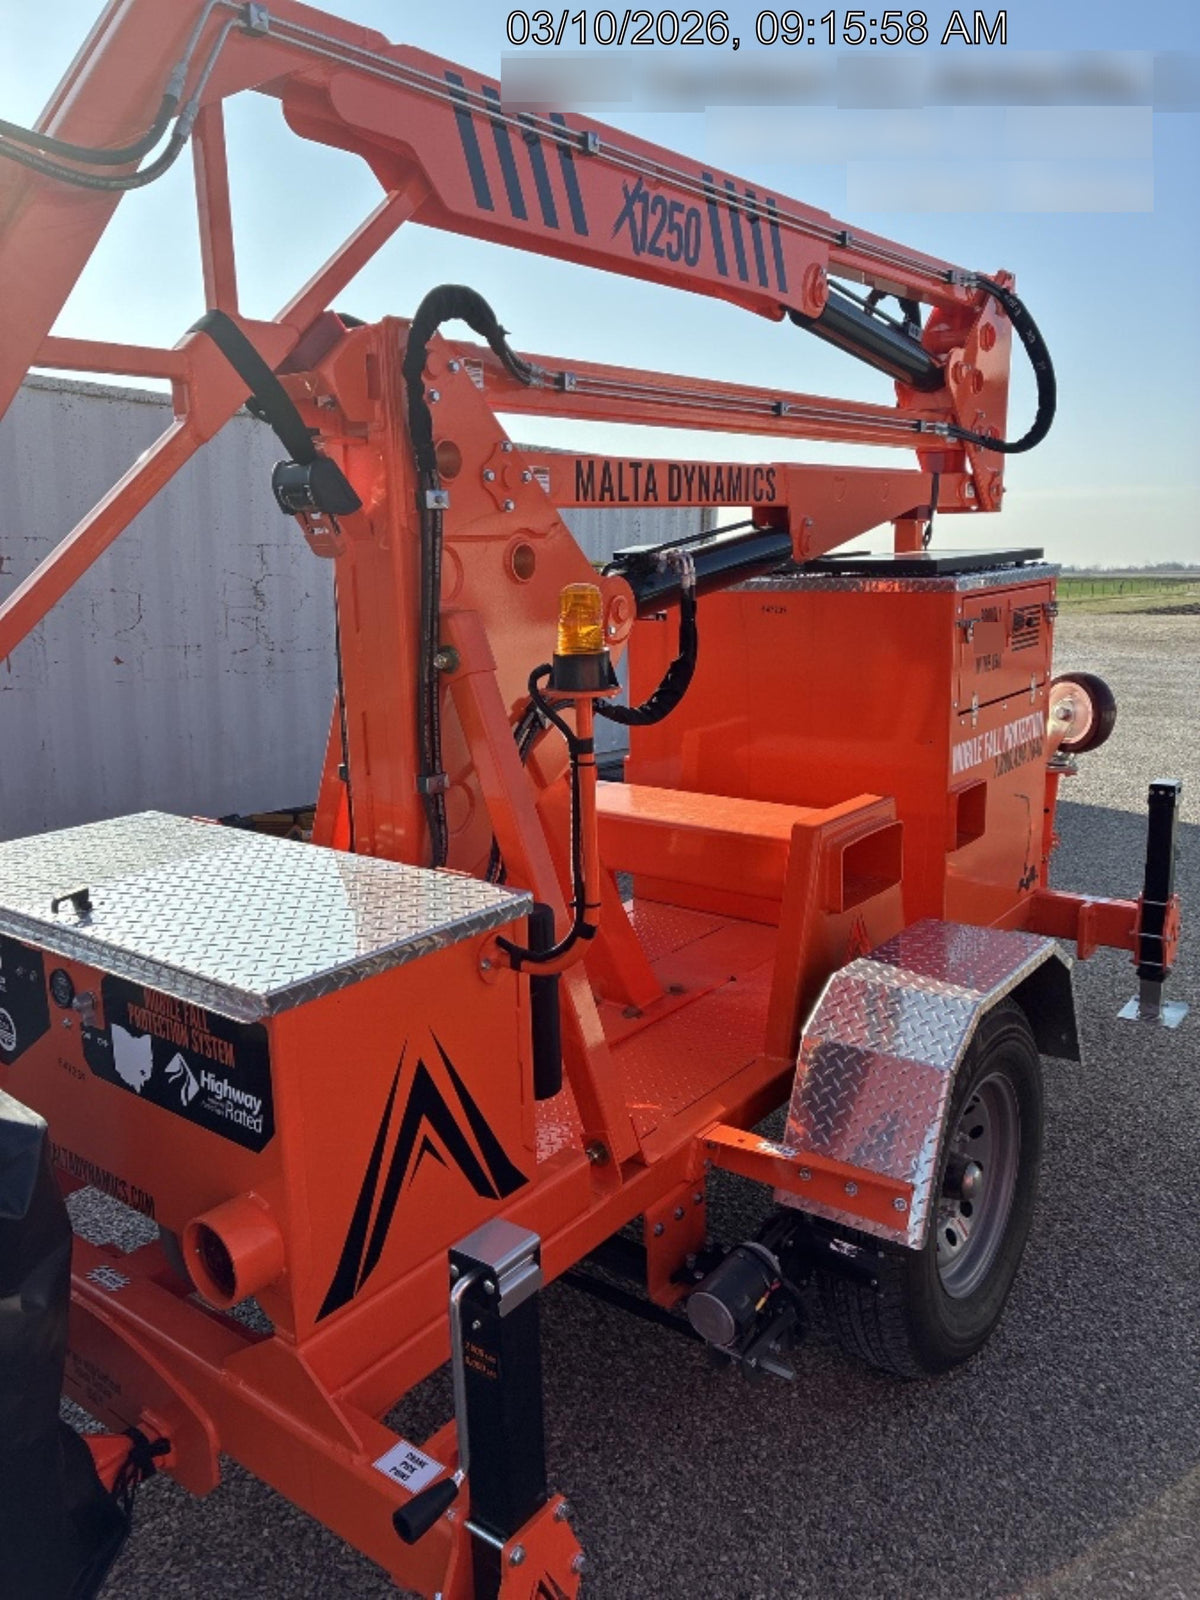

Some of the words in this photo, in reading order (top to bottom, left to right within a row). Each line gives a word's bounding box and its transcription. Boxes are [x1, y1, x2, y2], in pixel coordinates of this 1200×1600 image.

[611, 176, 702, 267] X1250
[575, 459, 659, 502] MALTA
[667, 463, 777, 503] DYNAMICS
[984, 727, 1002, 761] FALL
[127, 1001, 189, 1050] PROTECTION
[191, 1028, 236, 1069] SYSTEM
[183, 1001, 211, 1035] FALL
[200, 1069, 262, 1116] Highway
[225, 1100, 264, 1133] Rated
